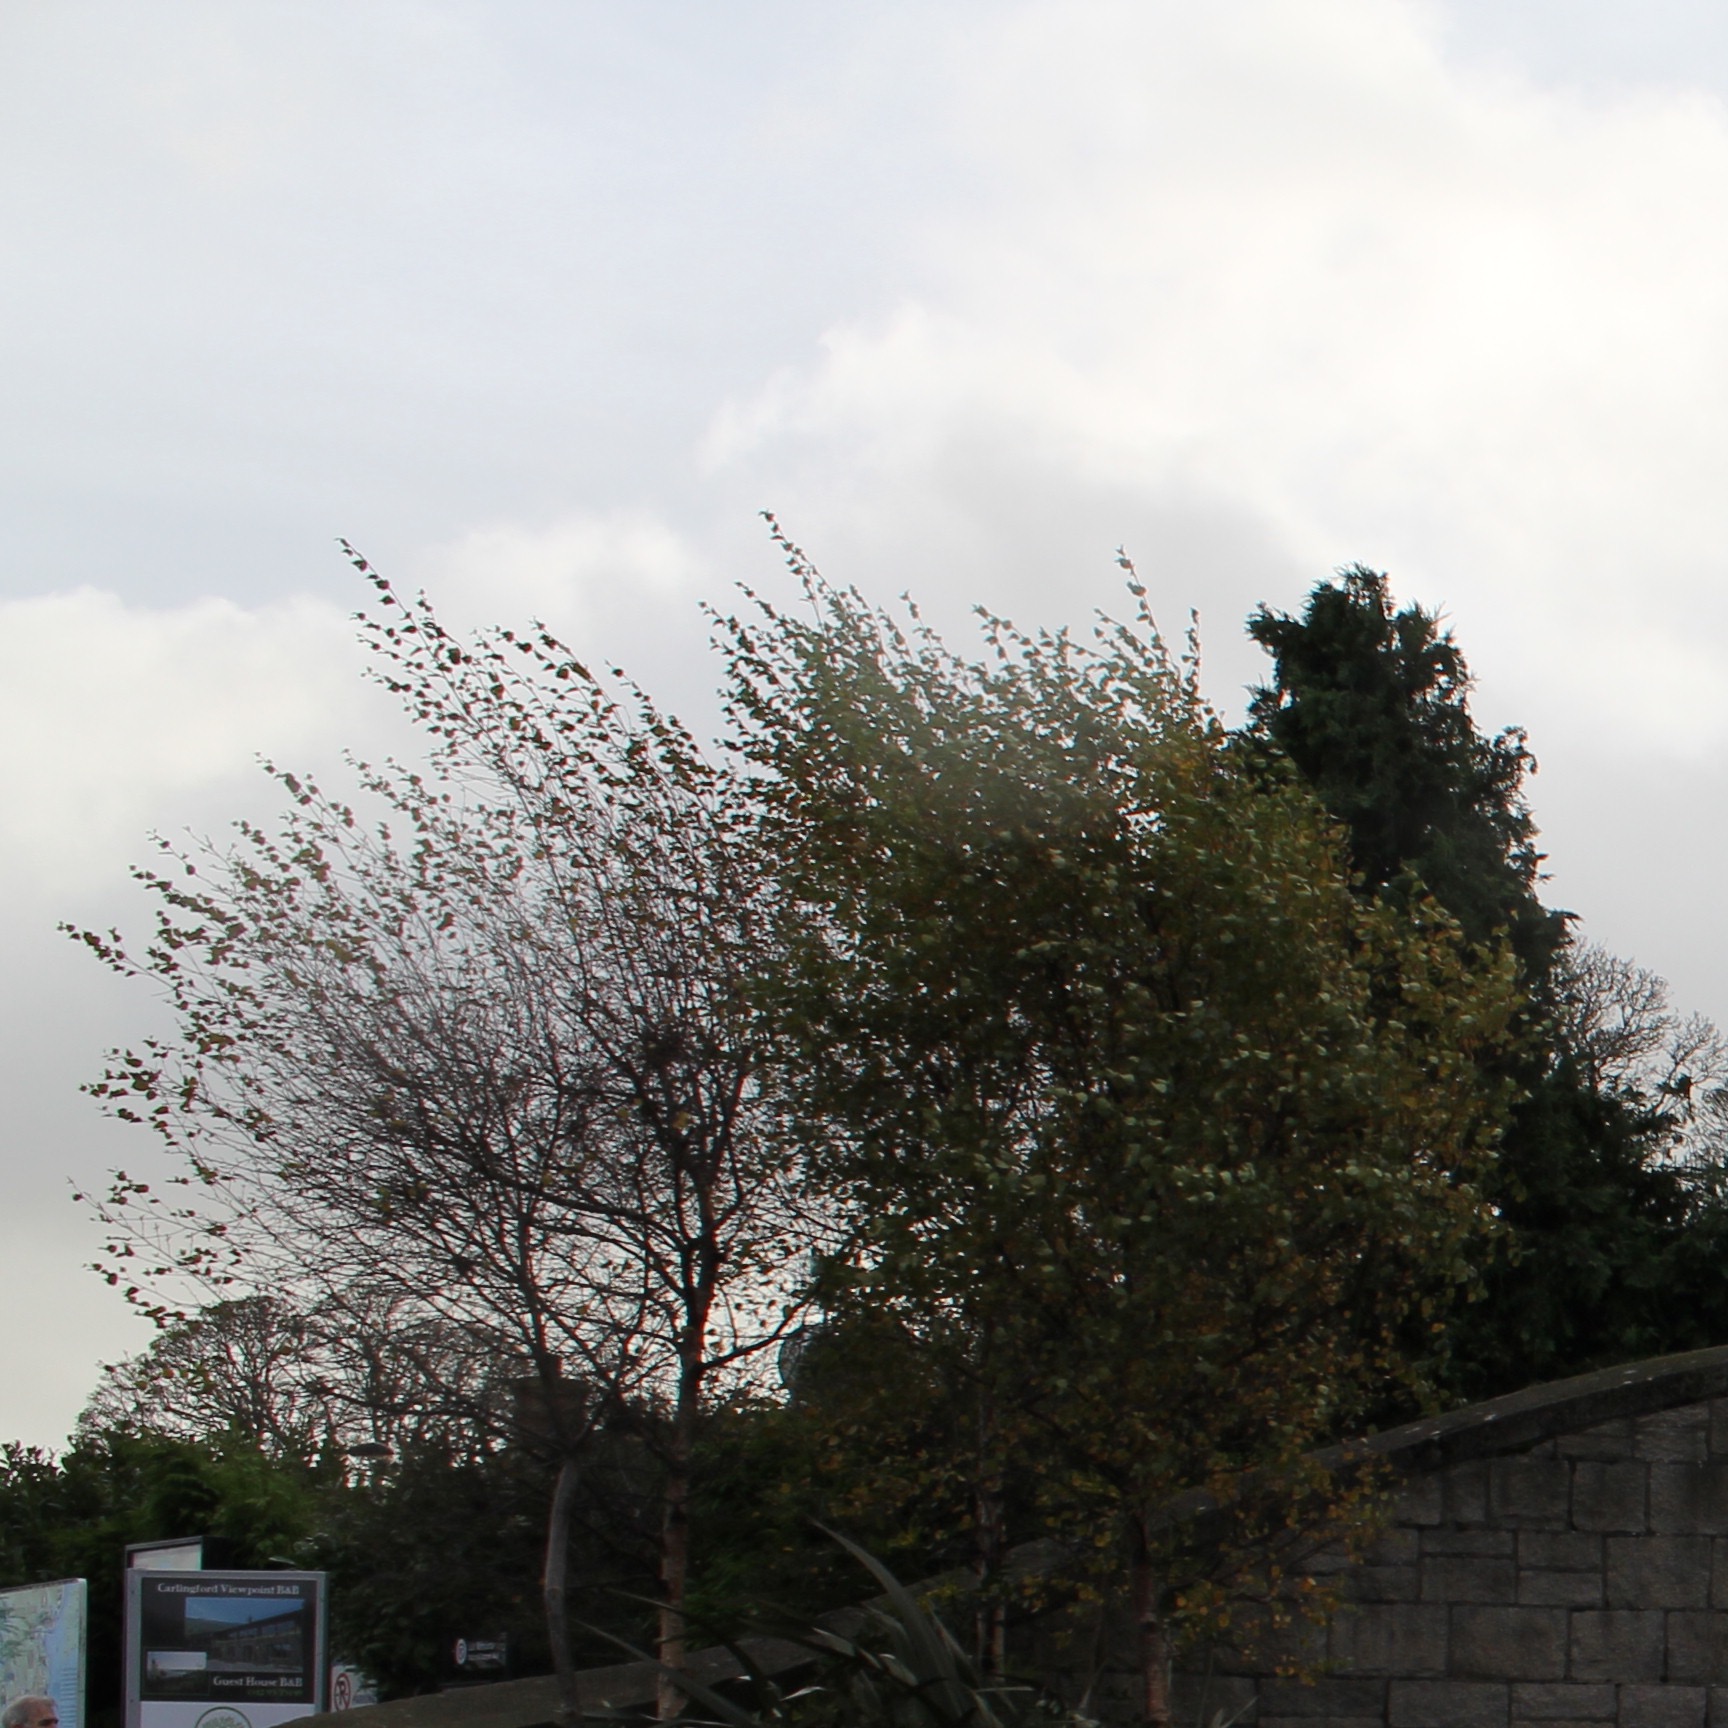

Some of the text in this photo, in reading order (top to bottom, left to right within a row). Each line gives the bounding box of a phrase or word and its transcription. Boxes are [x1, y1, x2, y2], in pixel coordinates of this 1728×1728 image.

[157, 1582, 300, 1596] Carlingford Viewpoint B&B
[212, 1676, 303, 1687] Guest House B&B
